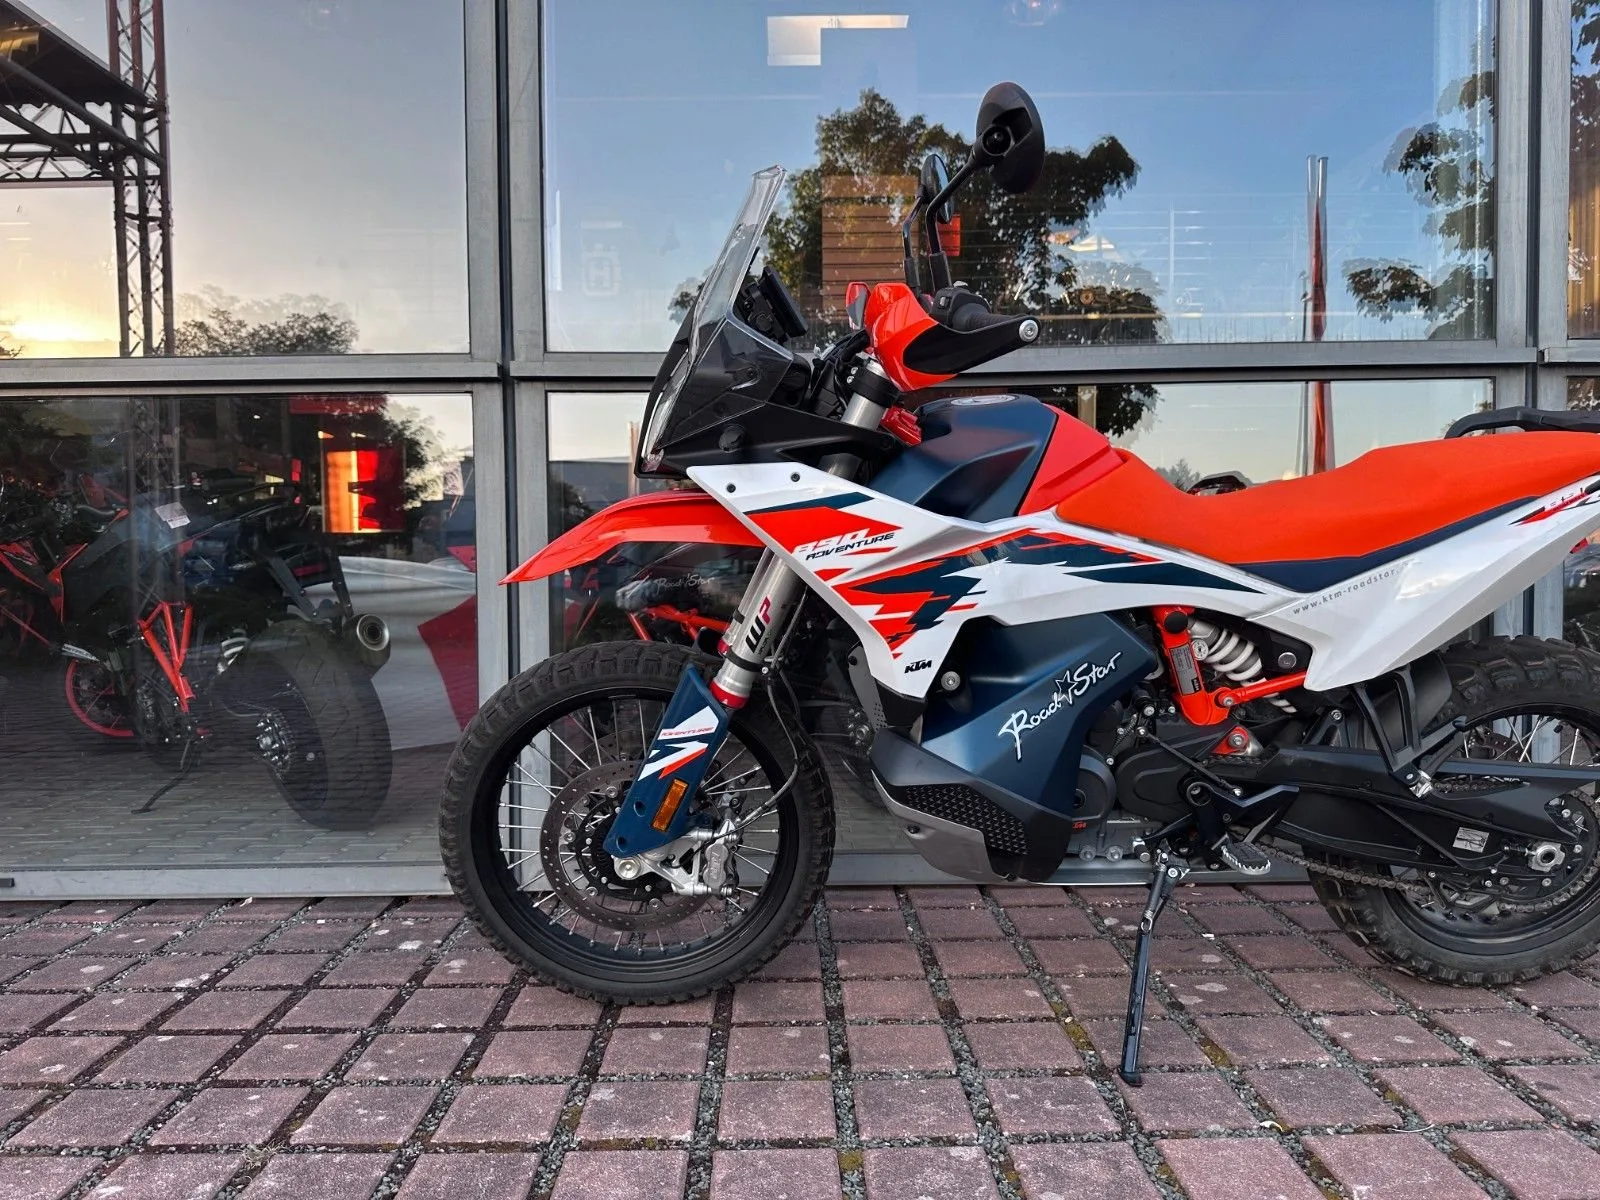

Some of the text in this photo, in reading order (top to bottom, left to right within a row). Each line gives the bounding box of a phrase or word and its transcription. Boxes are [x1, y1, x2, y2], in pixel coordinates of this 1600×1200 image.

[805, 532, 895, 561] ADVENTURE
[904, 659, 932, 674] KTM
[998, 691, 1062, 760] Road
[1073, 651, 1122, 696] Star
